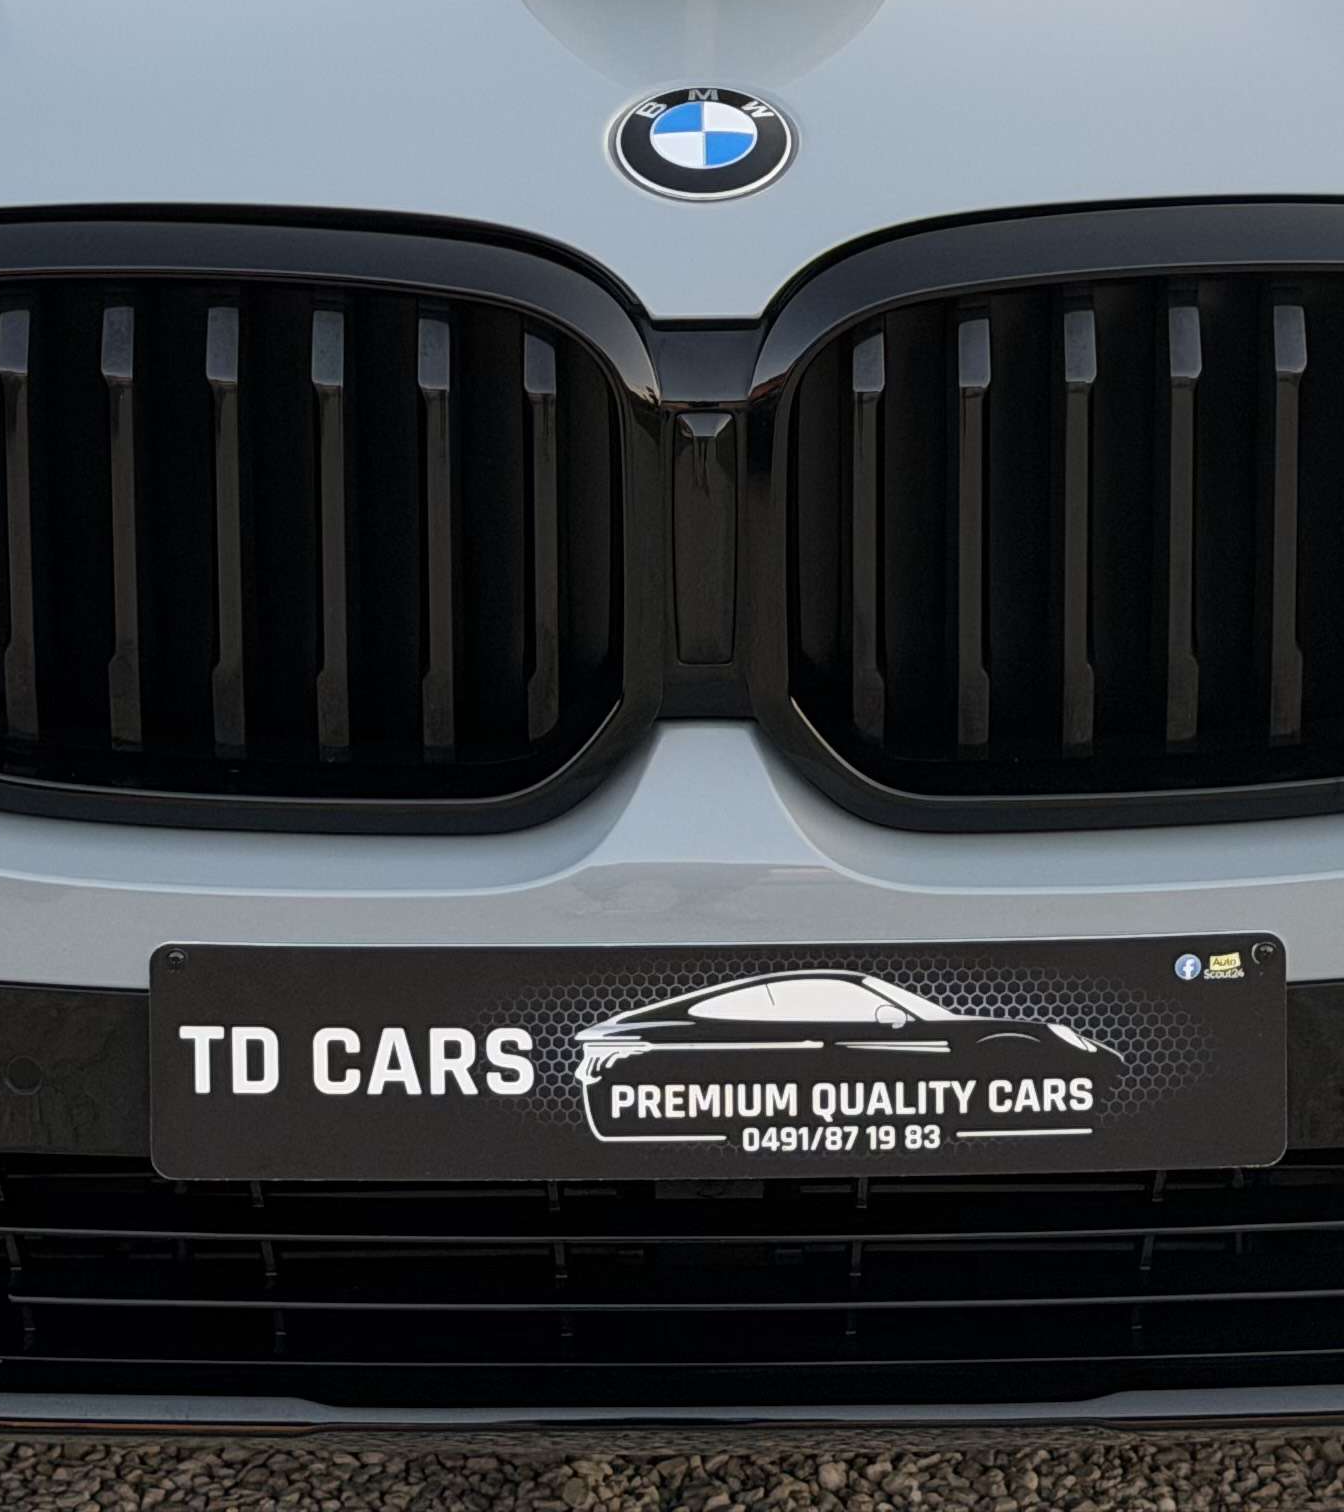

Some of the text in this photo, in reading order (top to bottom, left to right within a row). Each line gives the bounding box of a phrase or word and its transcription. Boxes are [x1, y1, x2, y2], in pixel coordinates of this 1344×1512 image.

[635, 88, 775, 119] BMW
[1203, 968, 1245, 980] Scout24
[178, 1025, 535, 1095] TD CARS
[611, 1077, 1094, 1122] PREMIUM QUALITY CARS
[742, 1124, 941, 1152] 0491/87 19 83
